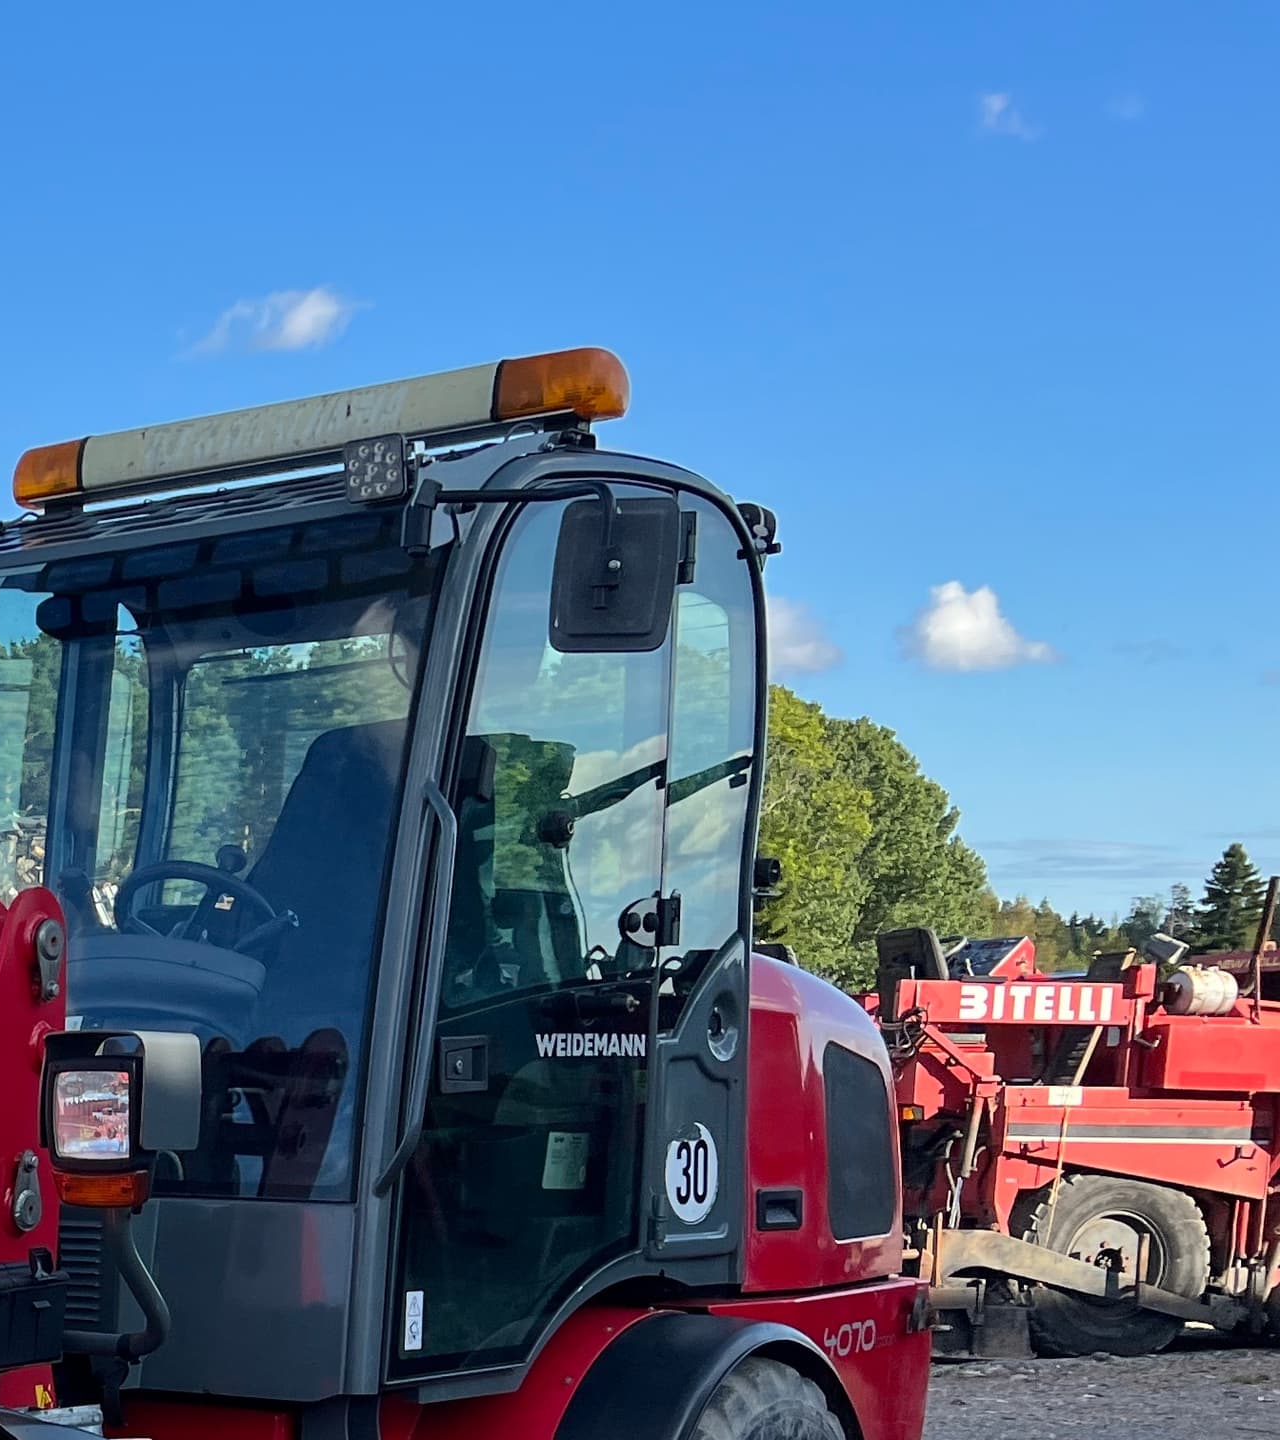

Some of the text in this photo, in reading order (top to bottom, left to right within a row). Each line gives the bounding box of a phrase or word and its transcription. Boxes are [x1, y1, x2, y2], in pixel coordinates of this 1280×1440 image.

[958, 984, 1114, 1022] BITELLI
[535, 1032, 647, 1058] WEIDEMANN
[675, 1140, 709, 1205] 30
[823, 1318, 877, 1358] 4070
